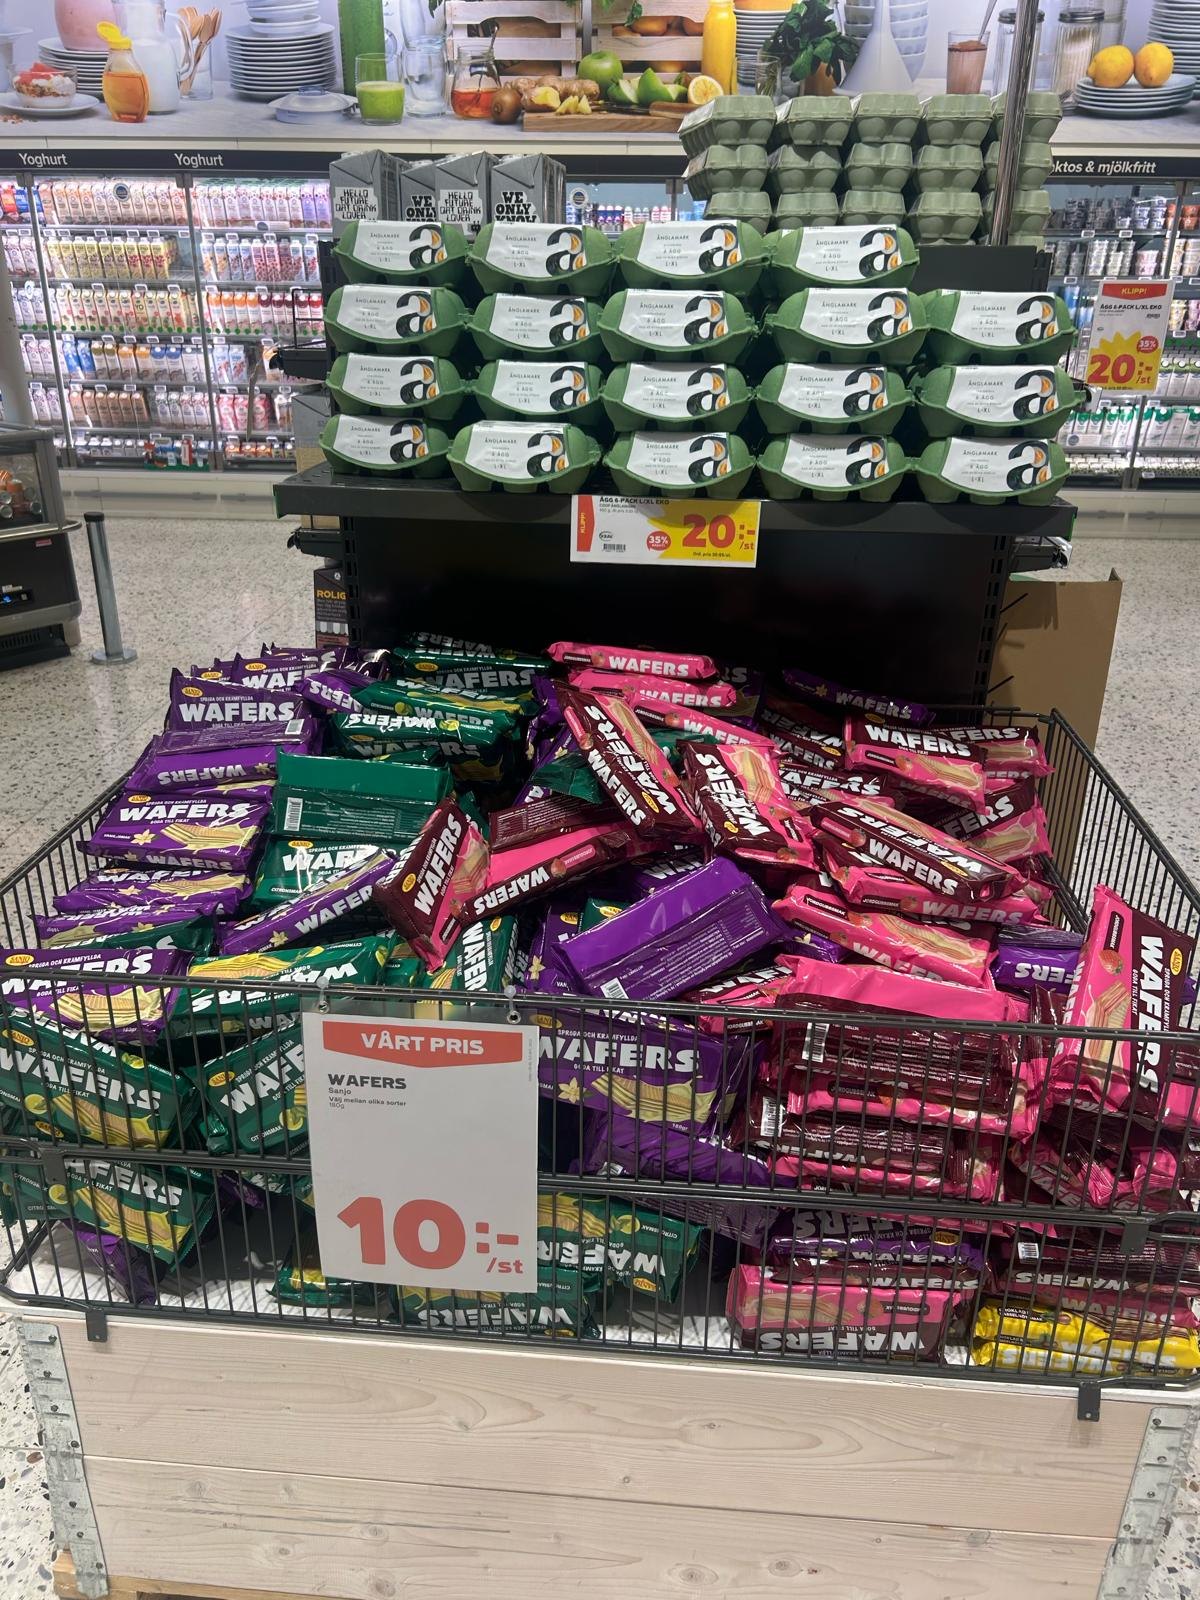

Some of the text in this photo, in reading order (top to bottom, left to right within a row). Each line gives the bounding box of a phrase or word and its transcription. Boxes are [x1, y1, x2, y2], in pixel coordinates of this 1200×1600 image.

[19, 154, 68, 168] Yoghurt
[175, 153, 223, 168] Yoghurt
[1085, 161, 1095, 172] &
[1098, 161, 1156, 175] mjölkfritt
[344, 189, 368, 197] HELLO
[412, 196, 432, 207] WE
[445, 199, 473, 207] FUTURE
[503, 192, 523, 203] WE
[496, 204, 531, 214] ONLY
[649, 536, 668, 544] 35%
[739, 541, 754, 550] /st
[317, 590, 346, 600] ROLIG
[608, 655, 689, 677] WAFERS
[640, 689, 722, 707] WAFERS
[836, 691, 912, 720] WAFERS
[179, 702, 294, 722] WAFERS
[349, 712, 438, 733] WAFERS
[865, 725, 971, 757] WAFERS
[952, 728, 1020, 741] FERS
[584, 705, 676, 814] WAFERS
[769, 734, 835, 770] WAFERS
[157, 764, 247, 785] WAFERS
[588, 749, 646, 825] WAFERS
[695, 753, 770, 836] WAFERS
[119, 802, 252, 822] WAFERS
[944, 796, 1014, 837] FERS
[838, 806, 982, 873] WAFERS
[146, 855, 232, 870] WAFERS
[414, 813, 461, 915] WAFERS
[868, 838, 958, 896] WAFERS
[474, 866, 550, 915] WAFERS
[295, 885, 373, 934] WAFER
[922, 901, 1023, 924] WAFERS
[10, 955, 30, 964] SANJO
[1136, 935, 1164, 1093] WAFERS
[361, 1031, 484, 1055] VÅRT PRIS
[539, 1036, 699, 1072] WAFERS
[0, 1048, 161, 1109] WAFERS
[328, 1074, 406, 1089] WAFERS
[329, 1087, 351, 1095] Sanjo
[486, 1257, 523, 1274] /st
[866, 1277, 979, 1290] WAFERS
[1016, 1272, 1130, 1291] WAFERS
[418, 1306, 573, 1326] WAFERS
[1062, 1297, 1175, 1324] WAFERS
[760, 1331, 925, 1351] WAFERS
